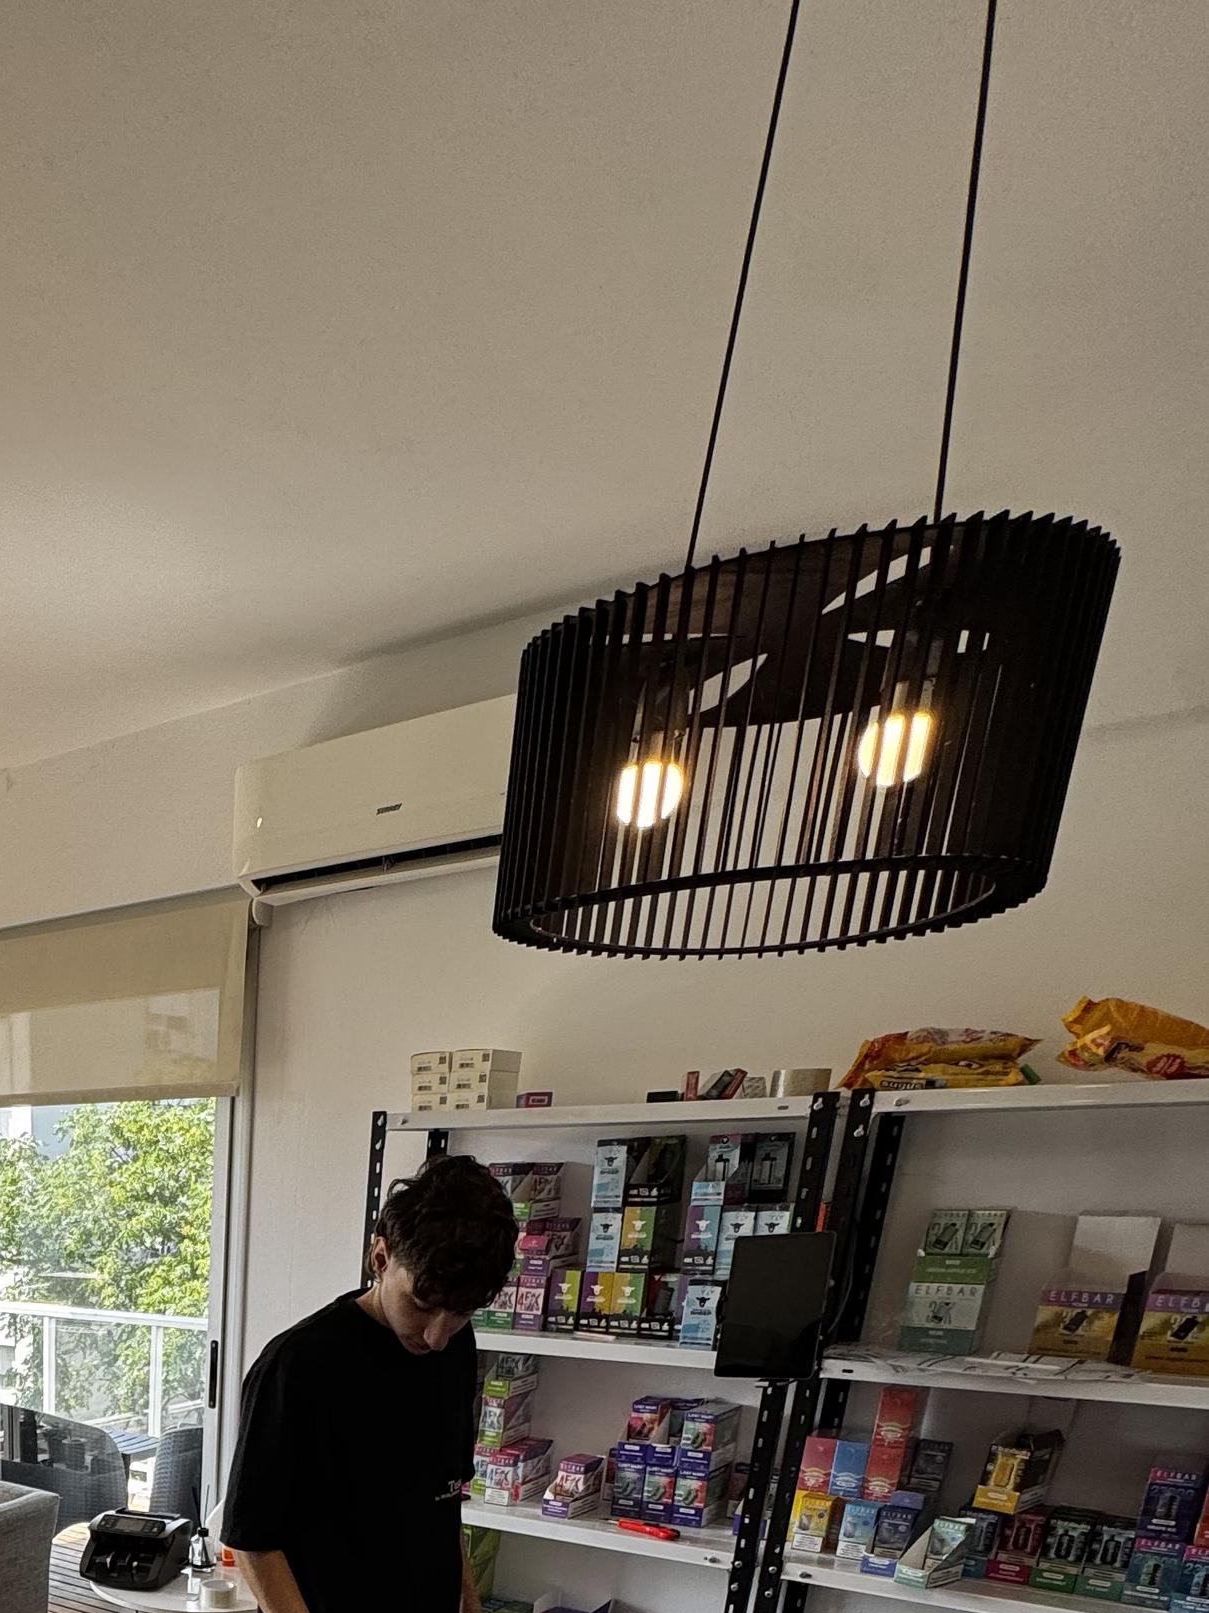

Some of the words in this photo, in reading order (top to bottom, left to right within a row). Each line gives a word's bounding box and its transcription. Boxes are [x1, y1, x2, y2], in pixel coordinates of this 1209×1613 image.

[915, 1285, 977, 1297] ELFBAR
[1049, 1290, 1114, 1305] ELFBAR
[1156, 1470, 1197, 1481] ELFBAR
